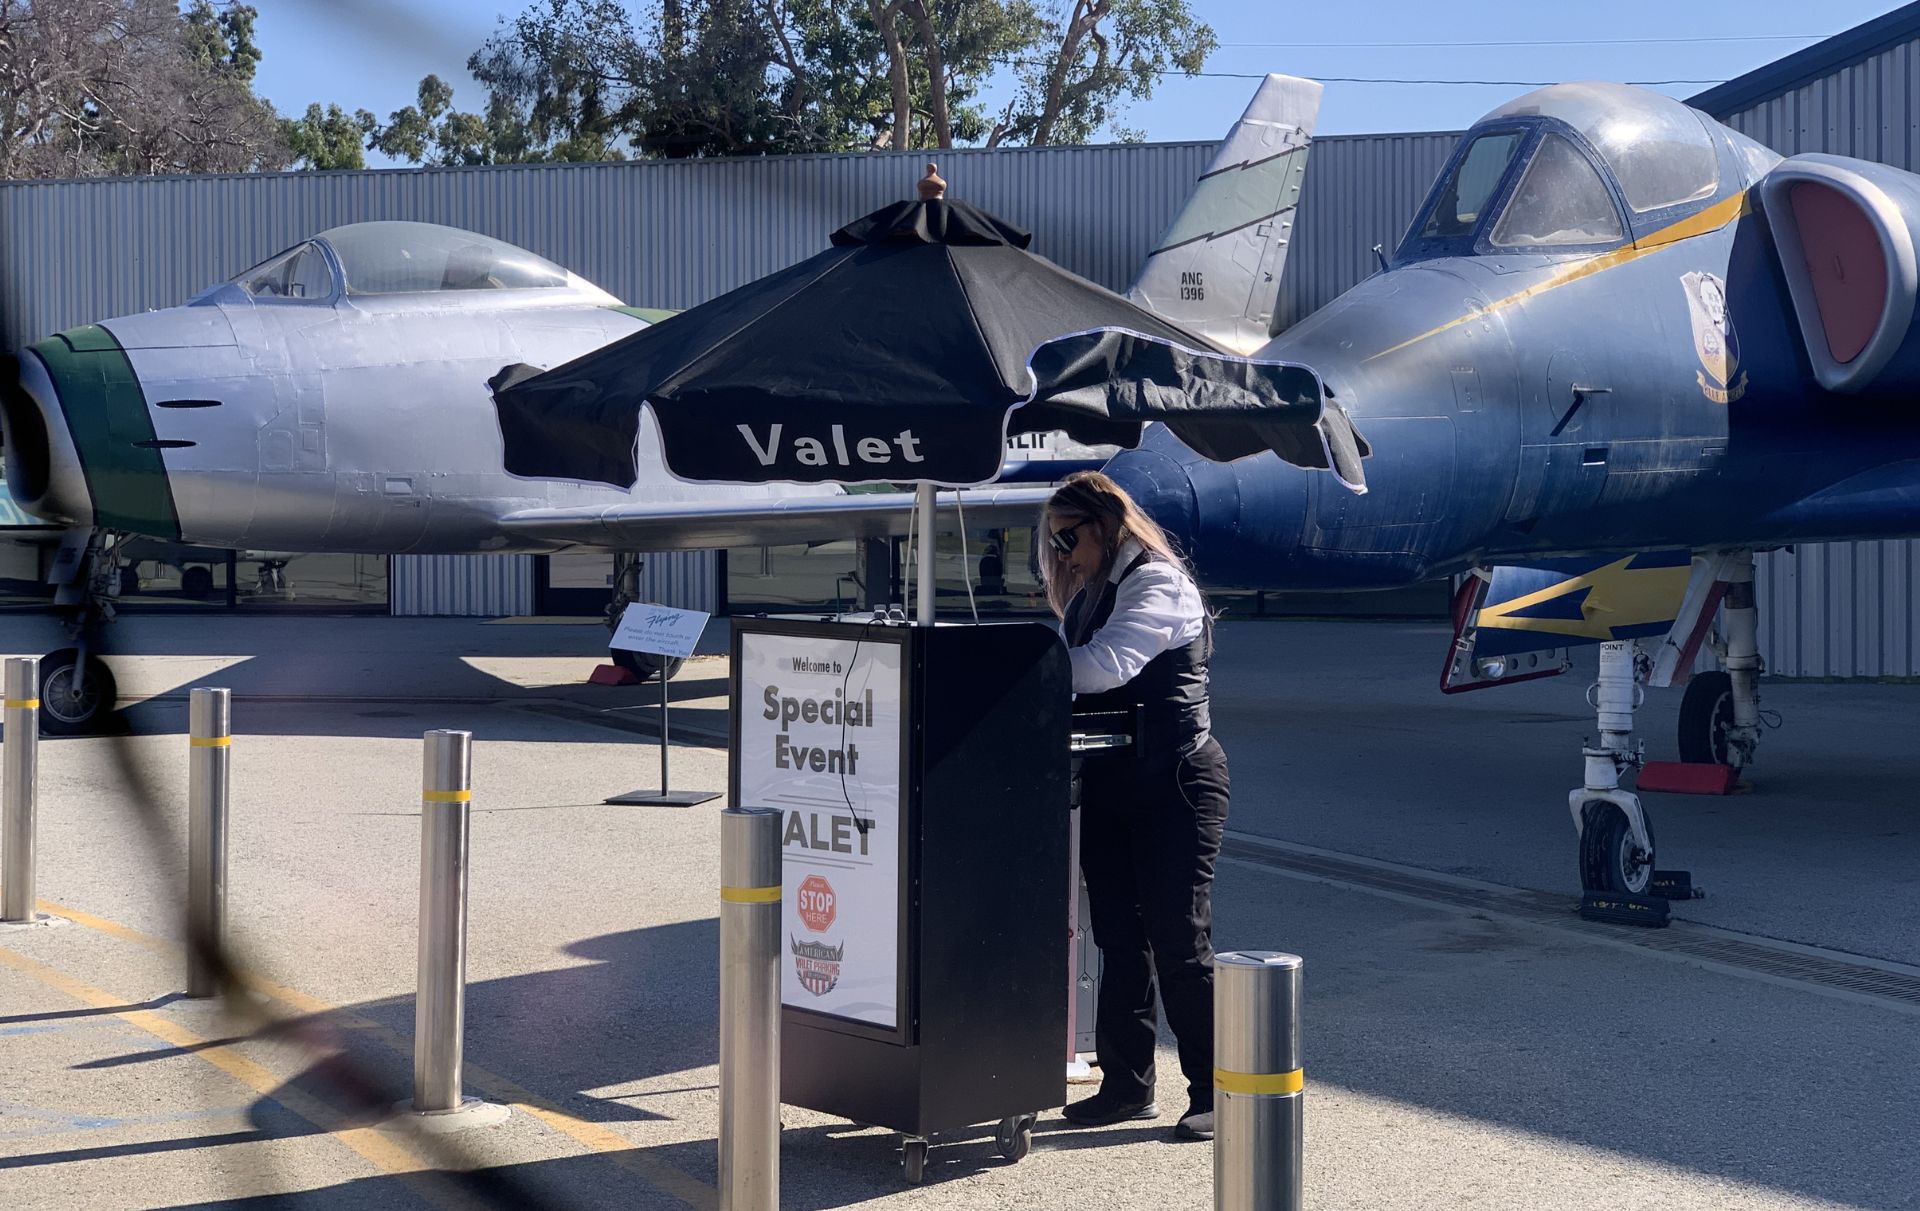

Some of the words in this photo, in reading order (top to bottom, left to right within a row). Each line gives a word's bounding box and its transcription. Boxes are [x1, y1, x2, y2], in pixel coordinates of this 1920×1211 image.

[1181, 272, 1203, 285] ANG
[1180, 287, 1204, 301] 1396
[736, 423, 925, 466] Valet
[792, 656, 831, 673] Welcome
[833, 660, 842, 674] to
[763, 685, 873, 732] Special
[775, 734, 859, 776] Event
[782, 809, 876, 856] ALET
[800, 889, 833, 913] STOP
[806, 912, 828, 924] HERE
[799, 946, 836, 961] AMERICAN
[795, 956, 813, 970] VALET
[814, 960, 840, 976] PARKING
